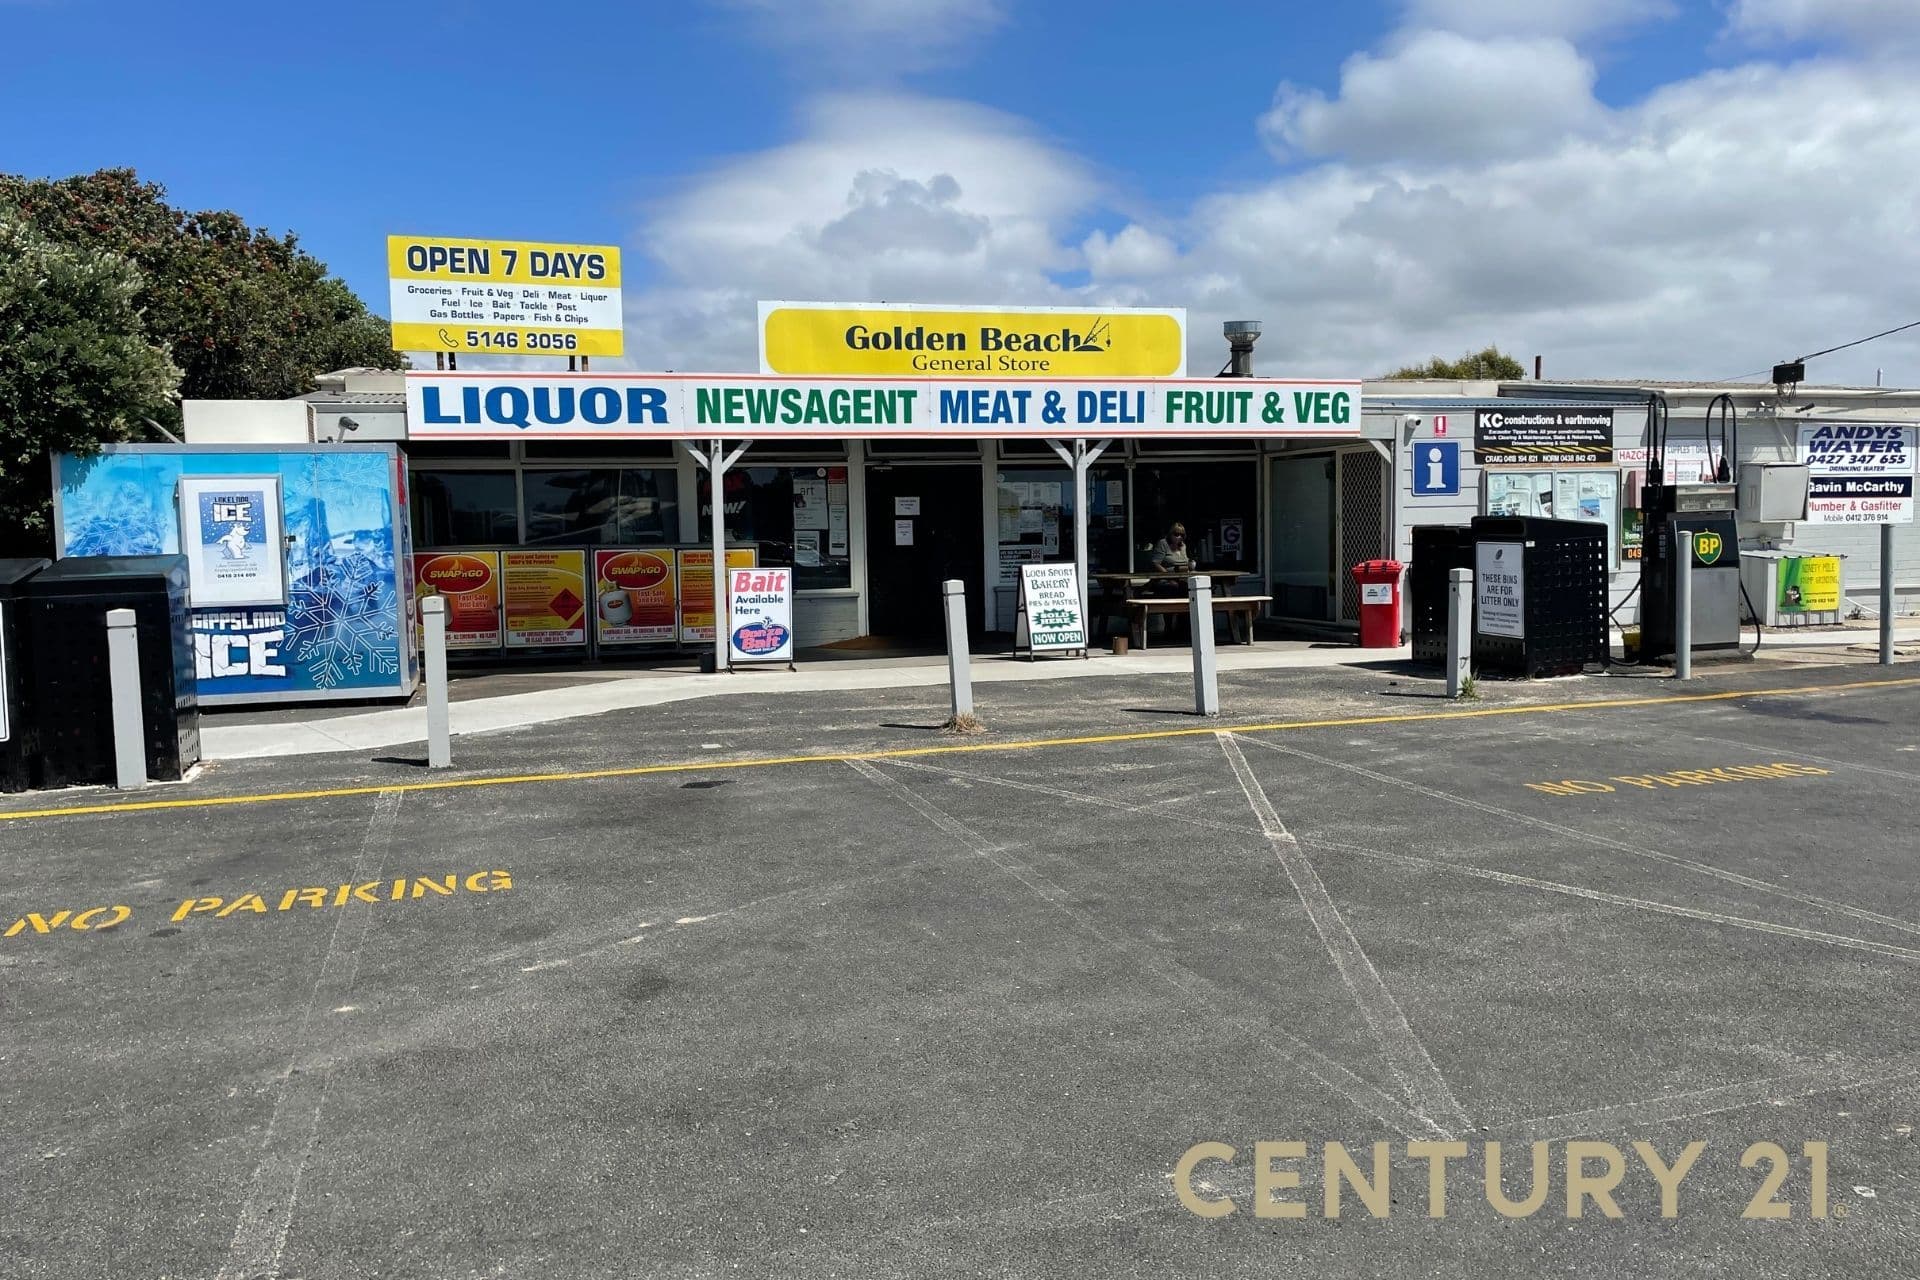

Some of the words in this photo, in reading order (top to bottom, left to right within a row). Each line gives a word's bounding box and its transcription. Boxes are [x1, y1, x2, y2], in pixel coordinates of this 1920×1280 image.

[407, 245, 490, 275] OPEN
[501, 250, 517, 275] 7
[530, 251, 605, 280] DAYS
[407, 285, 453, 296] Groceries
[461, 288, 484, 297] Fruit
[487, 288, 494, 297] &
[496, 289, 514, 300] Veg
[522, 290, 539, 299] Deli
[548, 291, 572, 300] Meat
[580, 292, 608, 303] Liquor
[441, 298, 461, 307] Fuel
[469, 299, 483, 308] Ice
[492, 300, 511, 309] Bait
[519, 301, 548, 310] Tackle
[556, 303, 577, 311] Post
[430, 309, 448, 318] Gas
[451, 310, 484, 319] Bottles
[493, 311, 525, 322] Papers
[534, 313, 552, 322] Fish
[554, 314, 562, 322] &
[564, 314, 589, 325] Chips
[466, 331, 518, 348] 5146
[526, 333, 577, 350] 3056
[845, 325, 966, 351] Golden
[981, 327, 1082, 352] Beach
[912, 354, 992, 371] General
[999, 355, 1050, 371] Store
[422, 386, 671, 429] LIQUOR
[697, 388, 918, 424] NEWSAGENT
[939, 390, 1032, 424] MEAT
[1041, 390, 1067, 425] &
[1077, 390, 1146, 424] DELI
[1166, 391, 1253, 424] FRUIT
[1261, 390, 1285, 424] &
[1293, 391, 1350, 424] VEG
[1479, 413, 1504, 428] KC
[1504, 414, 1554, 425] constructions
[1557, 414, 1562, 425] &
[1565, 414, 1611, 427] earthmoving
[1811, 426, 1903, 439] ANDYS
[1809, 440, 1905, 453] WATER
[1806, 455, 1845, 465] 0427
[1848, 455, 1875, 464] 347
[1879, 455, 1906, 464] 655
[1845, 482, 1905, 493] McCarthy
[213, 502, 253, 523] ICE
[702, 501, 746, 517] NW!
[1849, 501, 1857, 511] &
[1861, 500, 1902, 511] Gasfitter
[1845, 514, 1861, 522] 0412
[1699, 538, 1719, 554] BP
[1627, 549, 1642, 559] 049
[1025, 569, 1046, 578] LOCH
[1048, 568, 1073, 577] SPORT
[1482, 573, 1501, 583] THESE
[1502, 574, 1518, 584] BINS
[734, 572, 786, 592] Bait
[1031, 578, 1070, 590] BAKERY
[1039, 591, 1065, 599] BREAD
[1486, 585, 1499, 595] ARE
[1500, 585, 1513, 596] FOR
[735, 594, 784, 604] Available
[1481, 596, 1501, 606] LITTER
[1503, 597, 1519, 607] ONLY
[735, 606, 761, 615] Here
[192, 611, 286, 630] GIPPSLAND
[1033, 633, 1056, 644] NOW
[1057, 632, 1081, 642] OPEN
[194, 630, 286, 680] ICE
[1523, 780, 1616, 795] NO
[1608, 763, 1834, 789] PARKING
[3, 907, 131, 937] NO
[171, 870, 513, 922] PARKING
